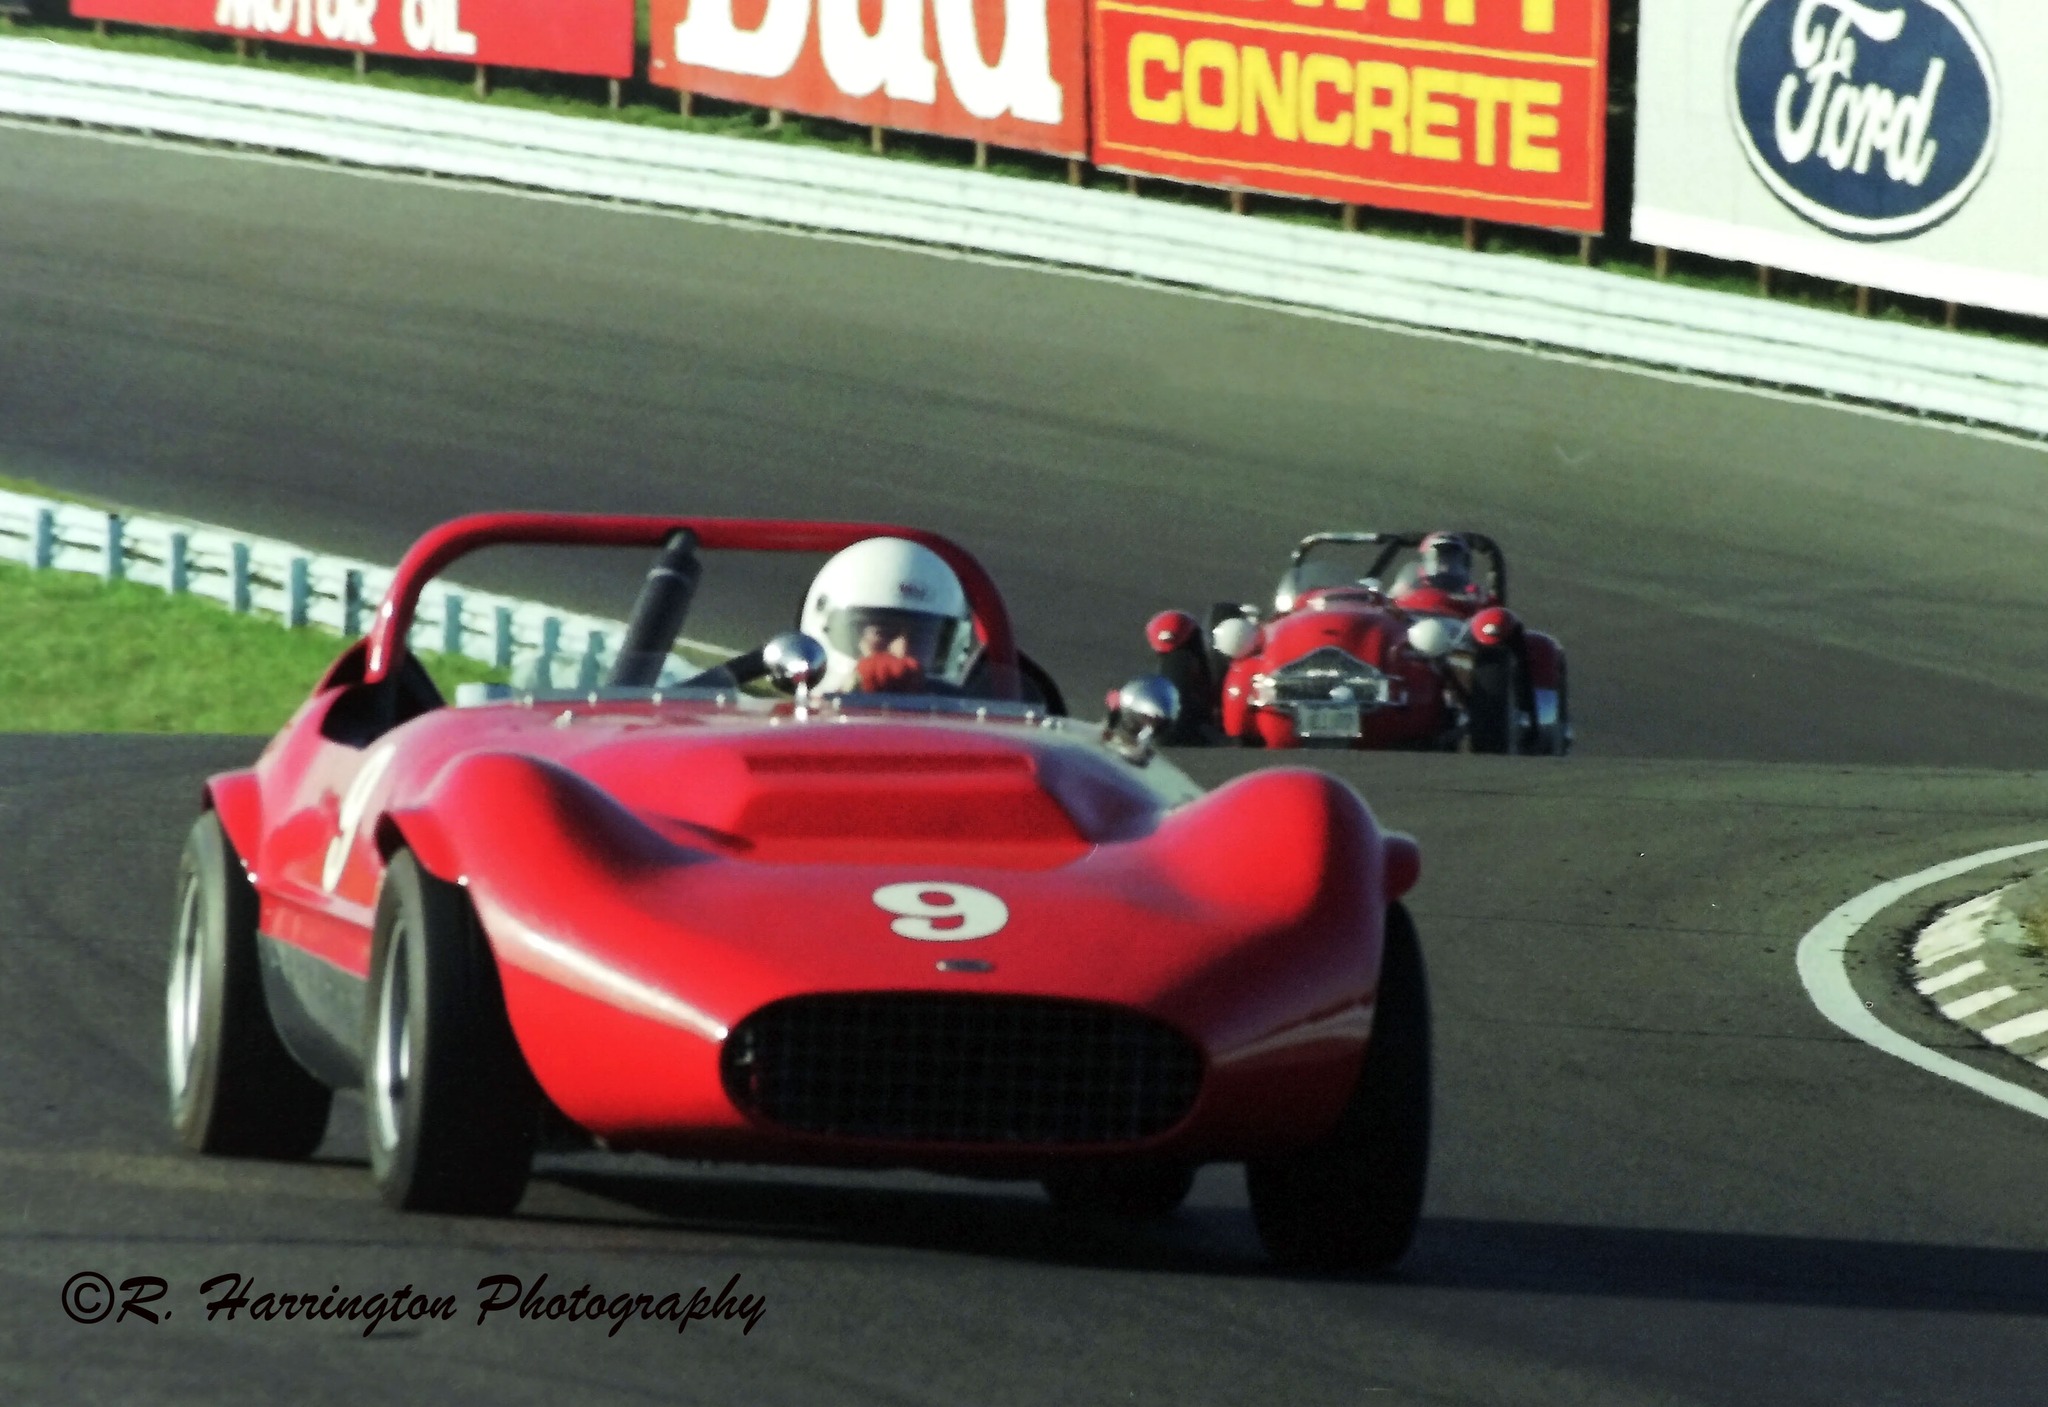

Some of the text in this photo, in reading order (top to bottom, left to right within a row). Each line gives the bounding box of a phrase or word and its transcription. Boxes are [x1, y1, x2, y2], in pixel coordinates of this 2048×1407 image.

[401, 0, 478, 56] OIL
[1127, 31, 1562, 173] CONCRETE
[1774, 0, 1946, 187] Ford
[871, 880, 1009, 942] 9
